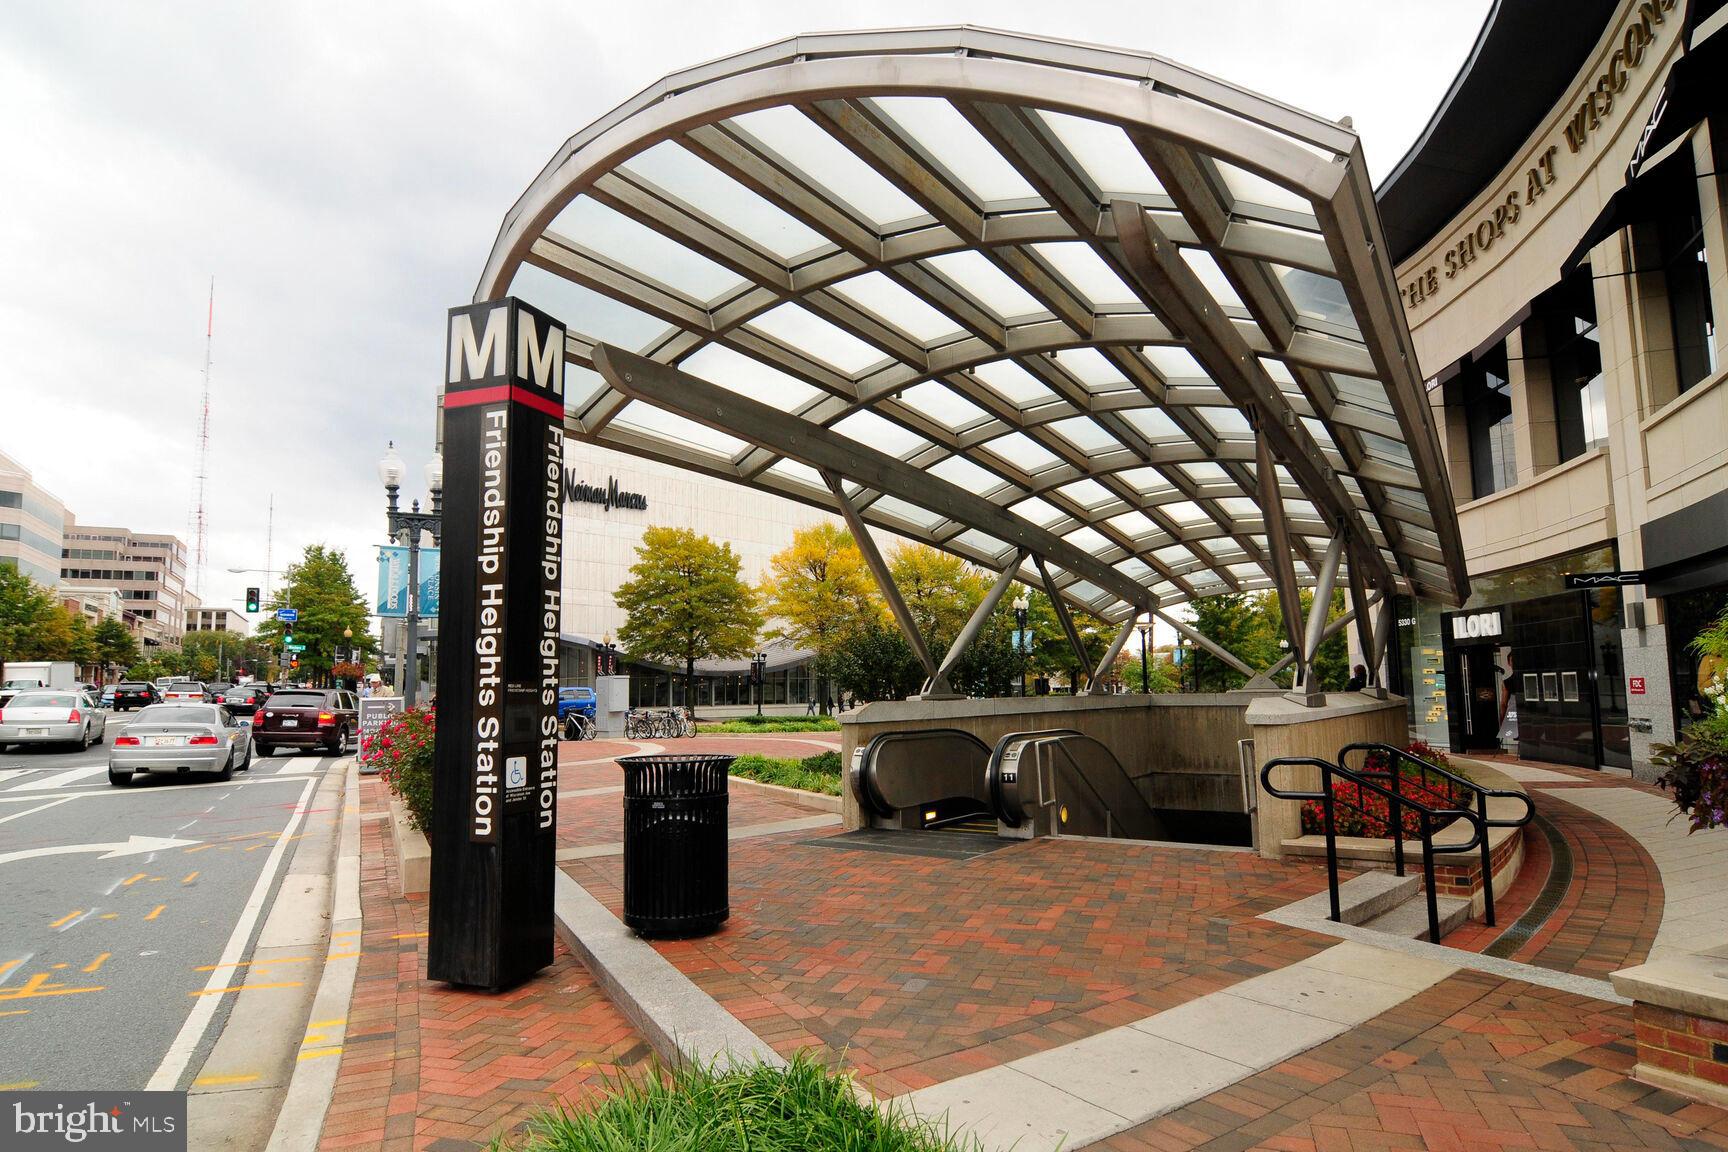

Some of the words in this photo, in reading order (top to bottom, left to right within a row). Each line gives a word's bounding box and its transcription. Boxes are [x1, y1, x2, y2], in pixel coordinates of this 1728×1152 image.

[1444, 190, 1522, 280] SHOPS
[1525, 144, 1559, 206] AT
[449, 306, 508, 383] M
[517, 308, 564, 396] M
[478, 410, 507, 574] Friendship
[541, 424, 563, 580] Friendship
[563, 467, 607, 504] Neiman
[605, 475, 648, 512] Marcus
[475, 583, 503, 707] Heights
[540, 589, 560, 705] Heights
[1398, 618, 1411, 627] 5330
[1411, 617, 1417, 625] G
[1452, 612, 1502, 639] ILORI
[475, 716, 500, 836] Station
[540, 715, 558, 828] Station
[1003, 773, 1014, 782] 11
